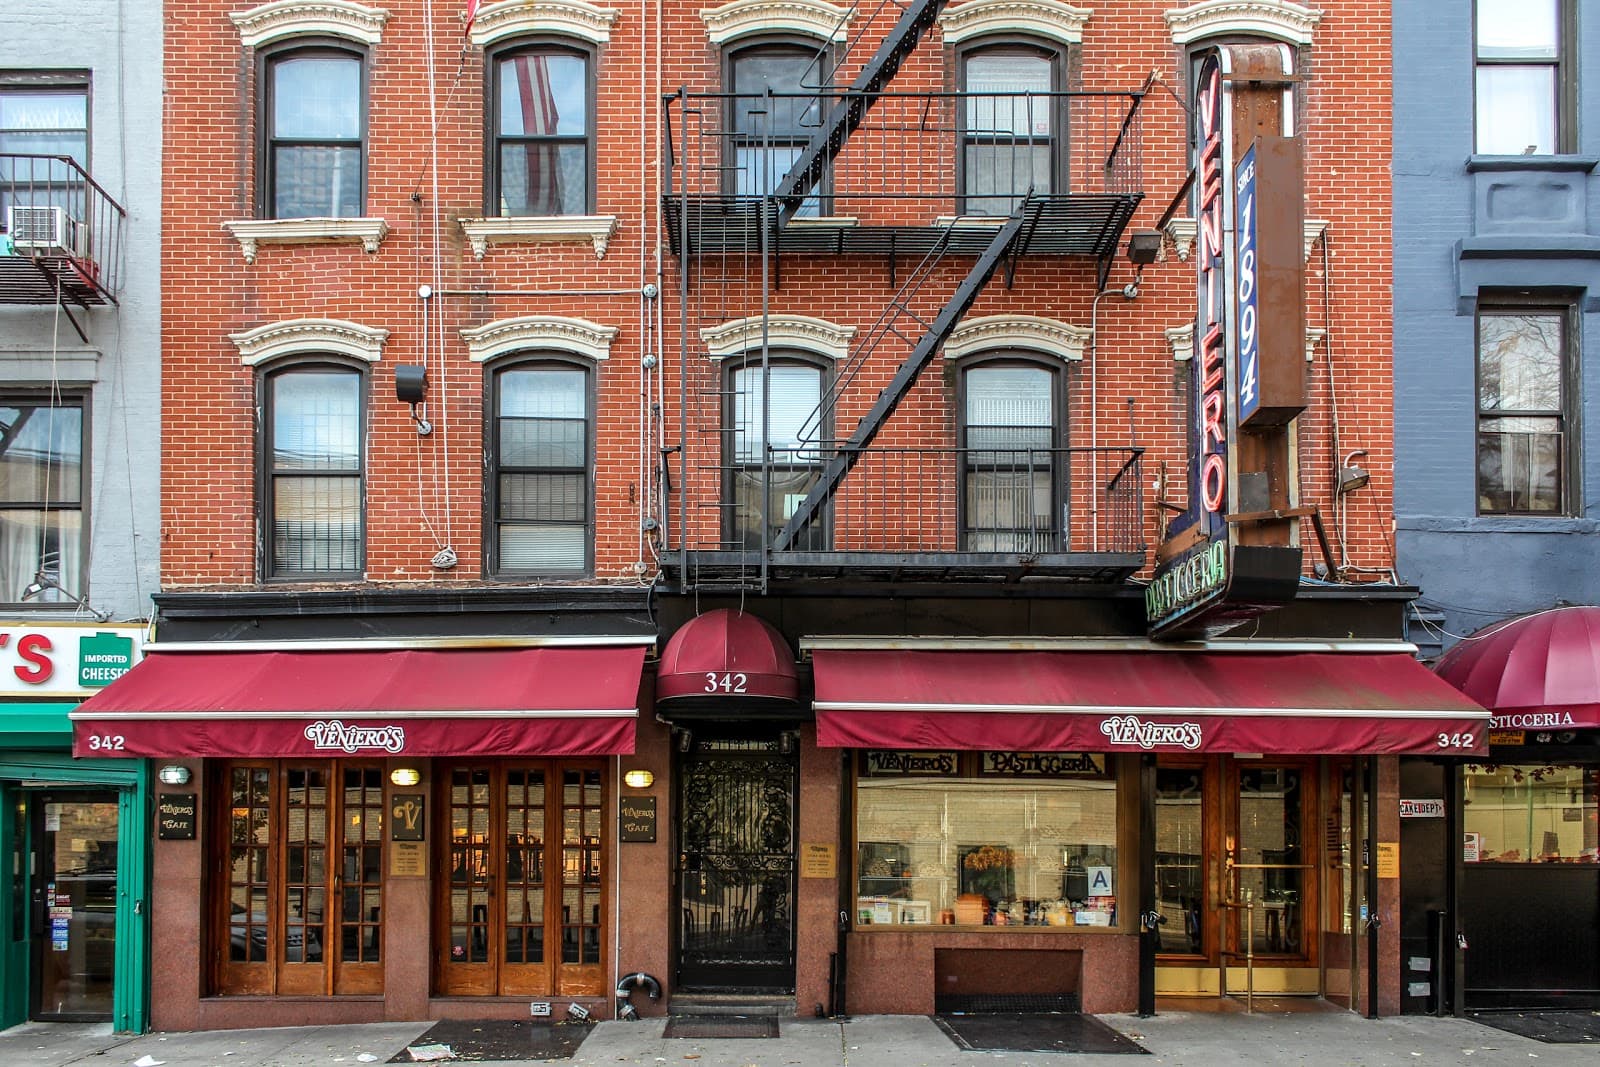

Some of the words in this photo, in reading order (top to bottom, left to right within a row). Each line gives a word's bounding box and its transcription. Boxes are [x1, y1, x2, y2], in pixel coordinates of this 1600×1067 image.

[1237, 161, 1254, 193] SINCE
[1199, 68, 1226, 513] VENIERO
[1239, 193, 1256, 407] 1894
[1145, 540, 1225, 621] PASTICCERIA
[85, 654, 127, 663] IMPORTED
[704, 672, 747, 693] 342
[1488, 712, 1574, 729] STICCERIA
[88, 735, 125, 751] 342
[1437, 733, 1474, 748] 342
[393, 801, 422, 830] V
[1093, 870, 1108, 888] A
